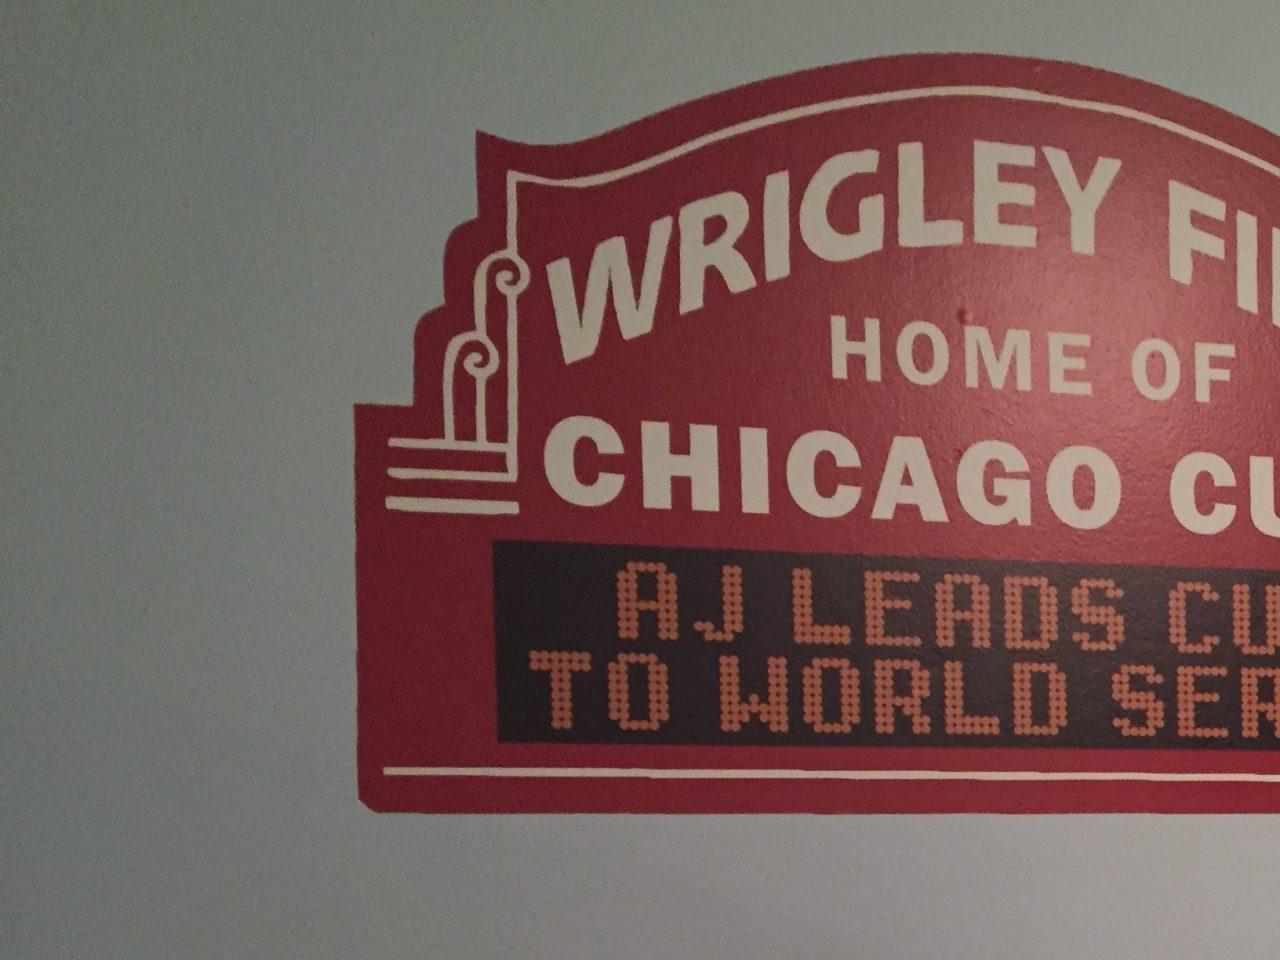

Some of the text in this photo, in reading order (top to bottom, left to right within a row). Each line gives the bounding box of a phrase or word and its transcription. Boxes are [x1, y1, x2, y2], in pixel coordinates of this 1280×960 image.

[546, 140, 1122, 364] WRIGLEY
[830, 315, 1235, 402] HOME OF
[544, 415, 1122, 529] CHICAGO
[616, 562, 743, 641] AJ
[793, 567, 1125, 651] LEADS
[529, 650, 669, 730] TO
[719, 655, 1068, 737] WORLD
